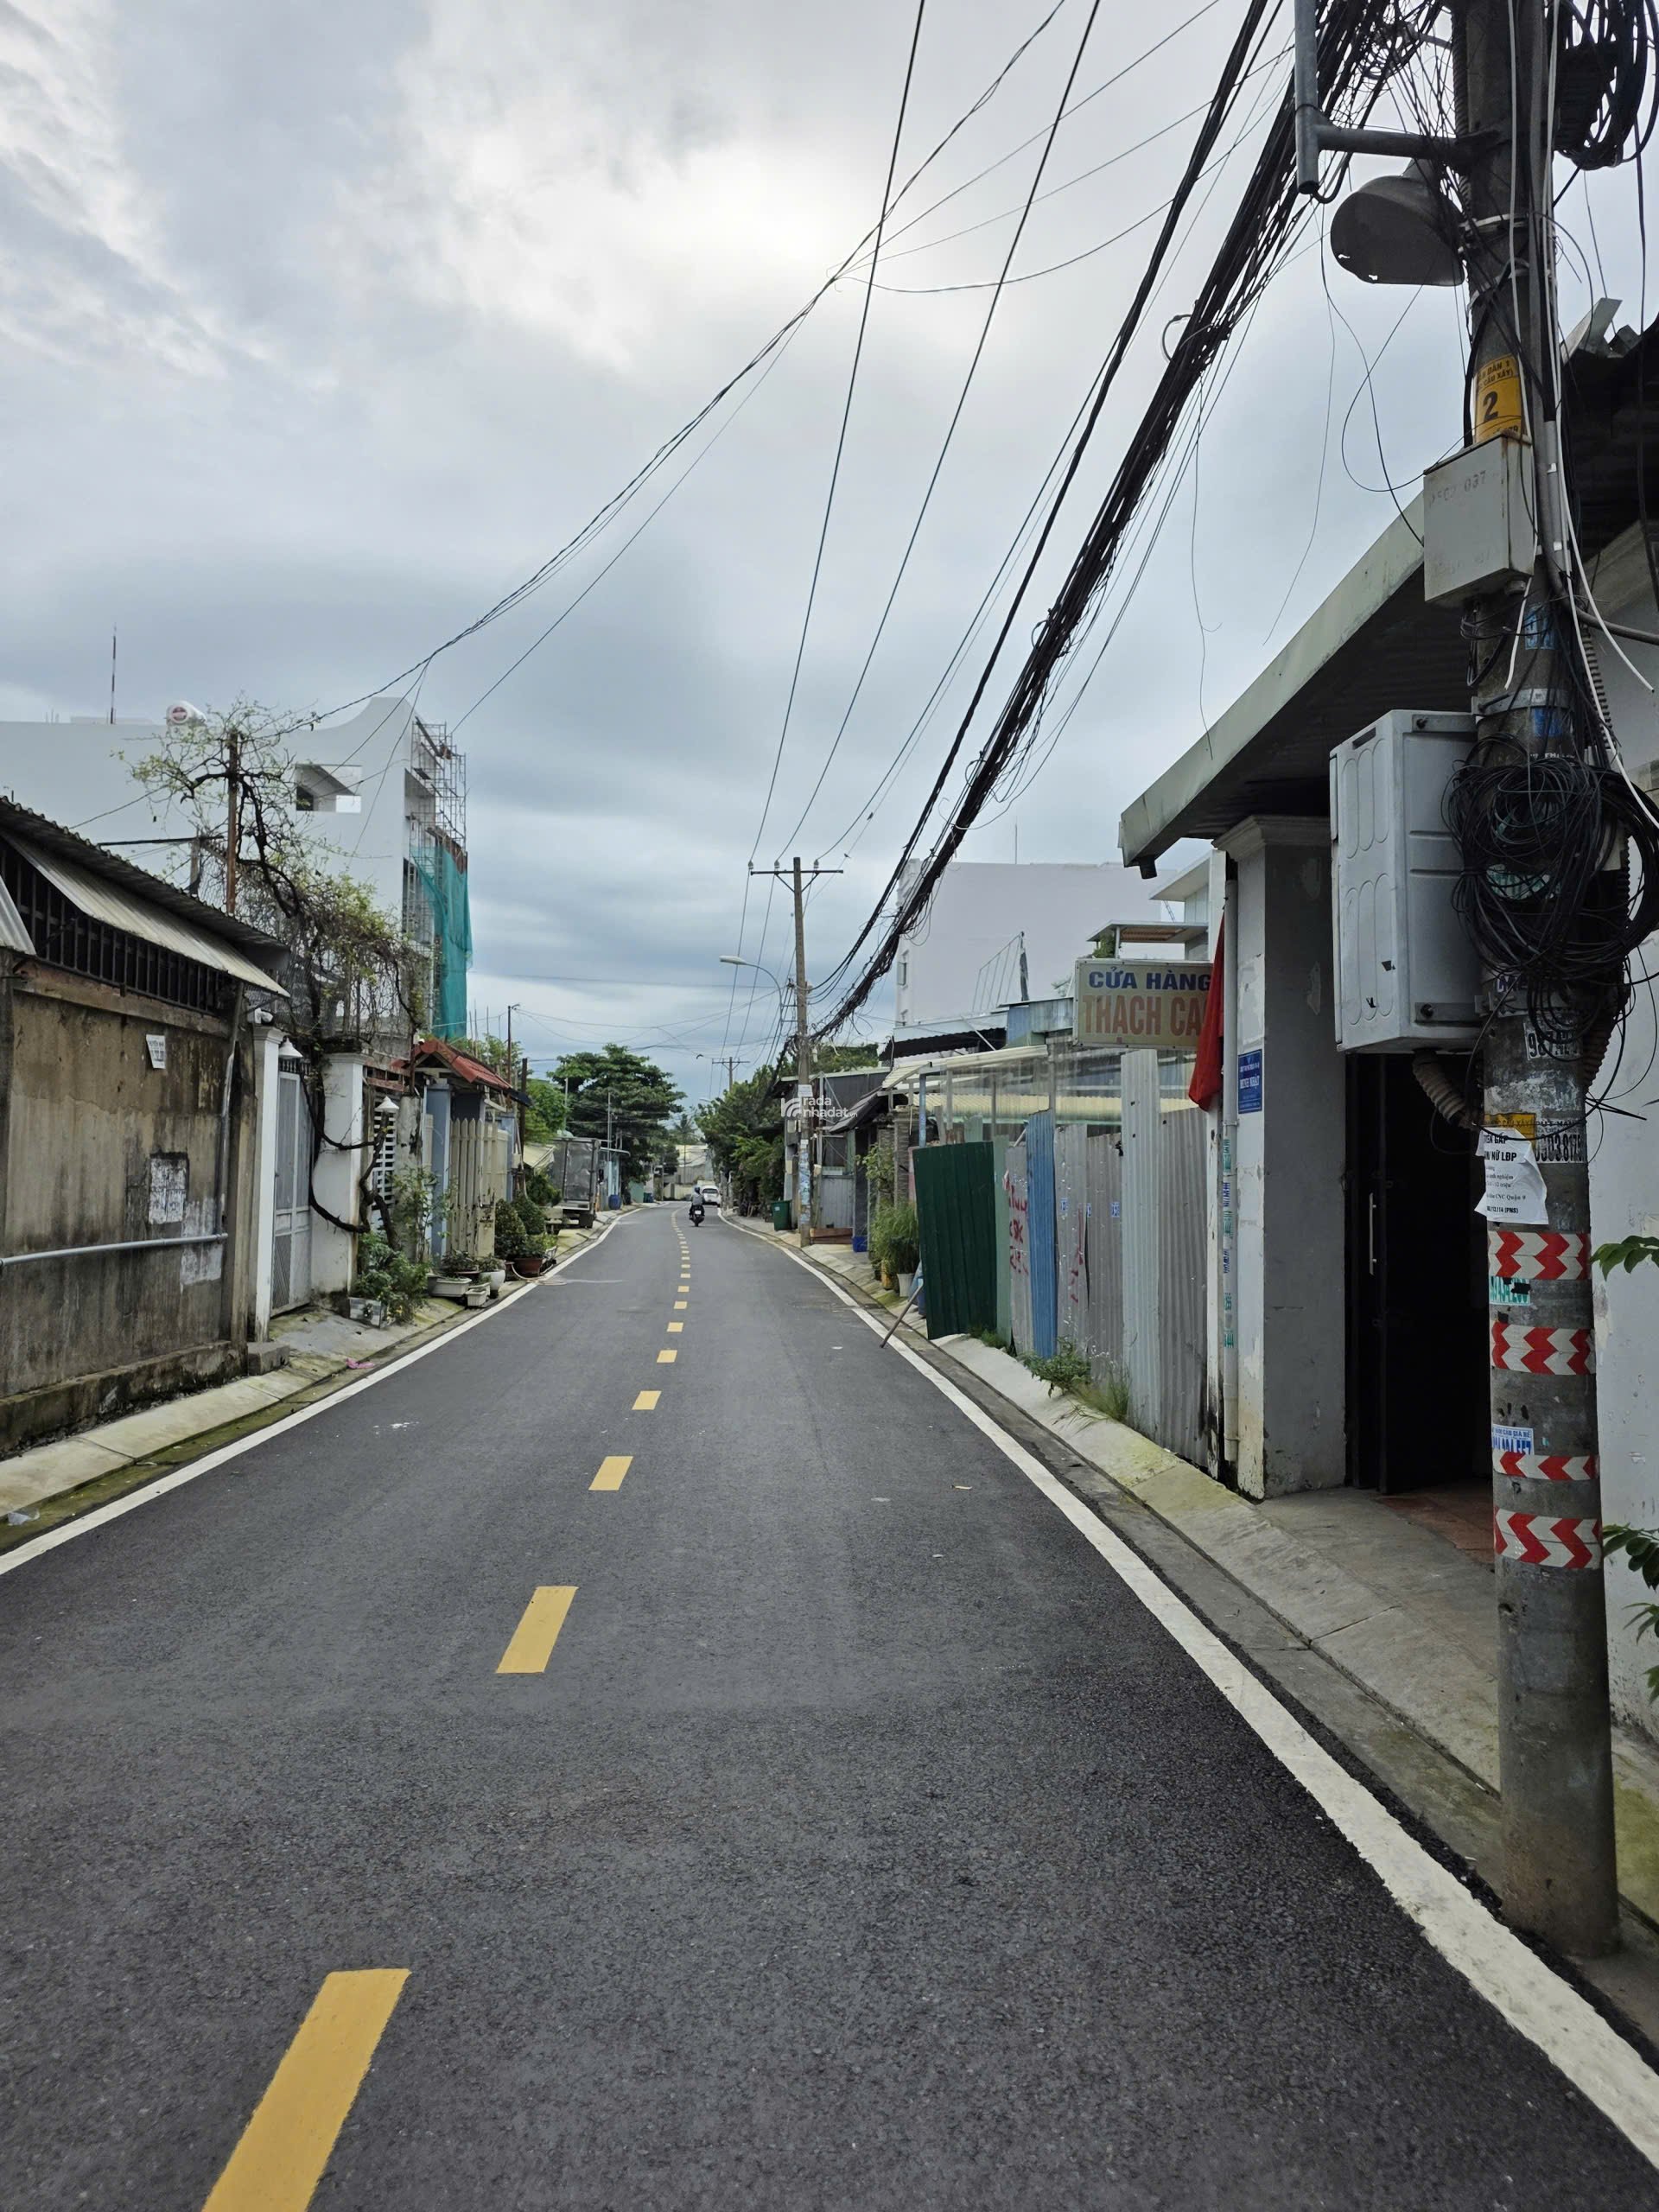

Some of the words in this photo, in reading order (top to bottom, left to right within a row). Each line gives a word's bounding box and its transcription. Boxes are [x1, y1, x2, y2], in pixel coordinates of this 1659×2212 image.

[1483, 391, 1498, 422] 2
[1089, 967, 1137, 989] CỬA
[1146, 969, 1211, 991] HÀNG
[1083, 995, 1161, 1044] THẠCH
[1170, 996, 1207, 1036] CA
